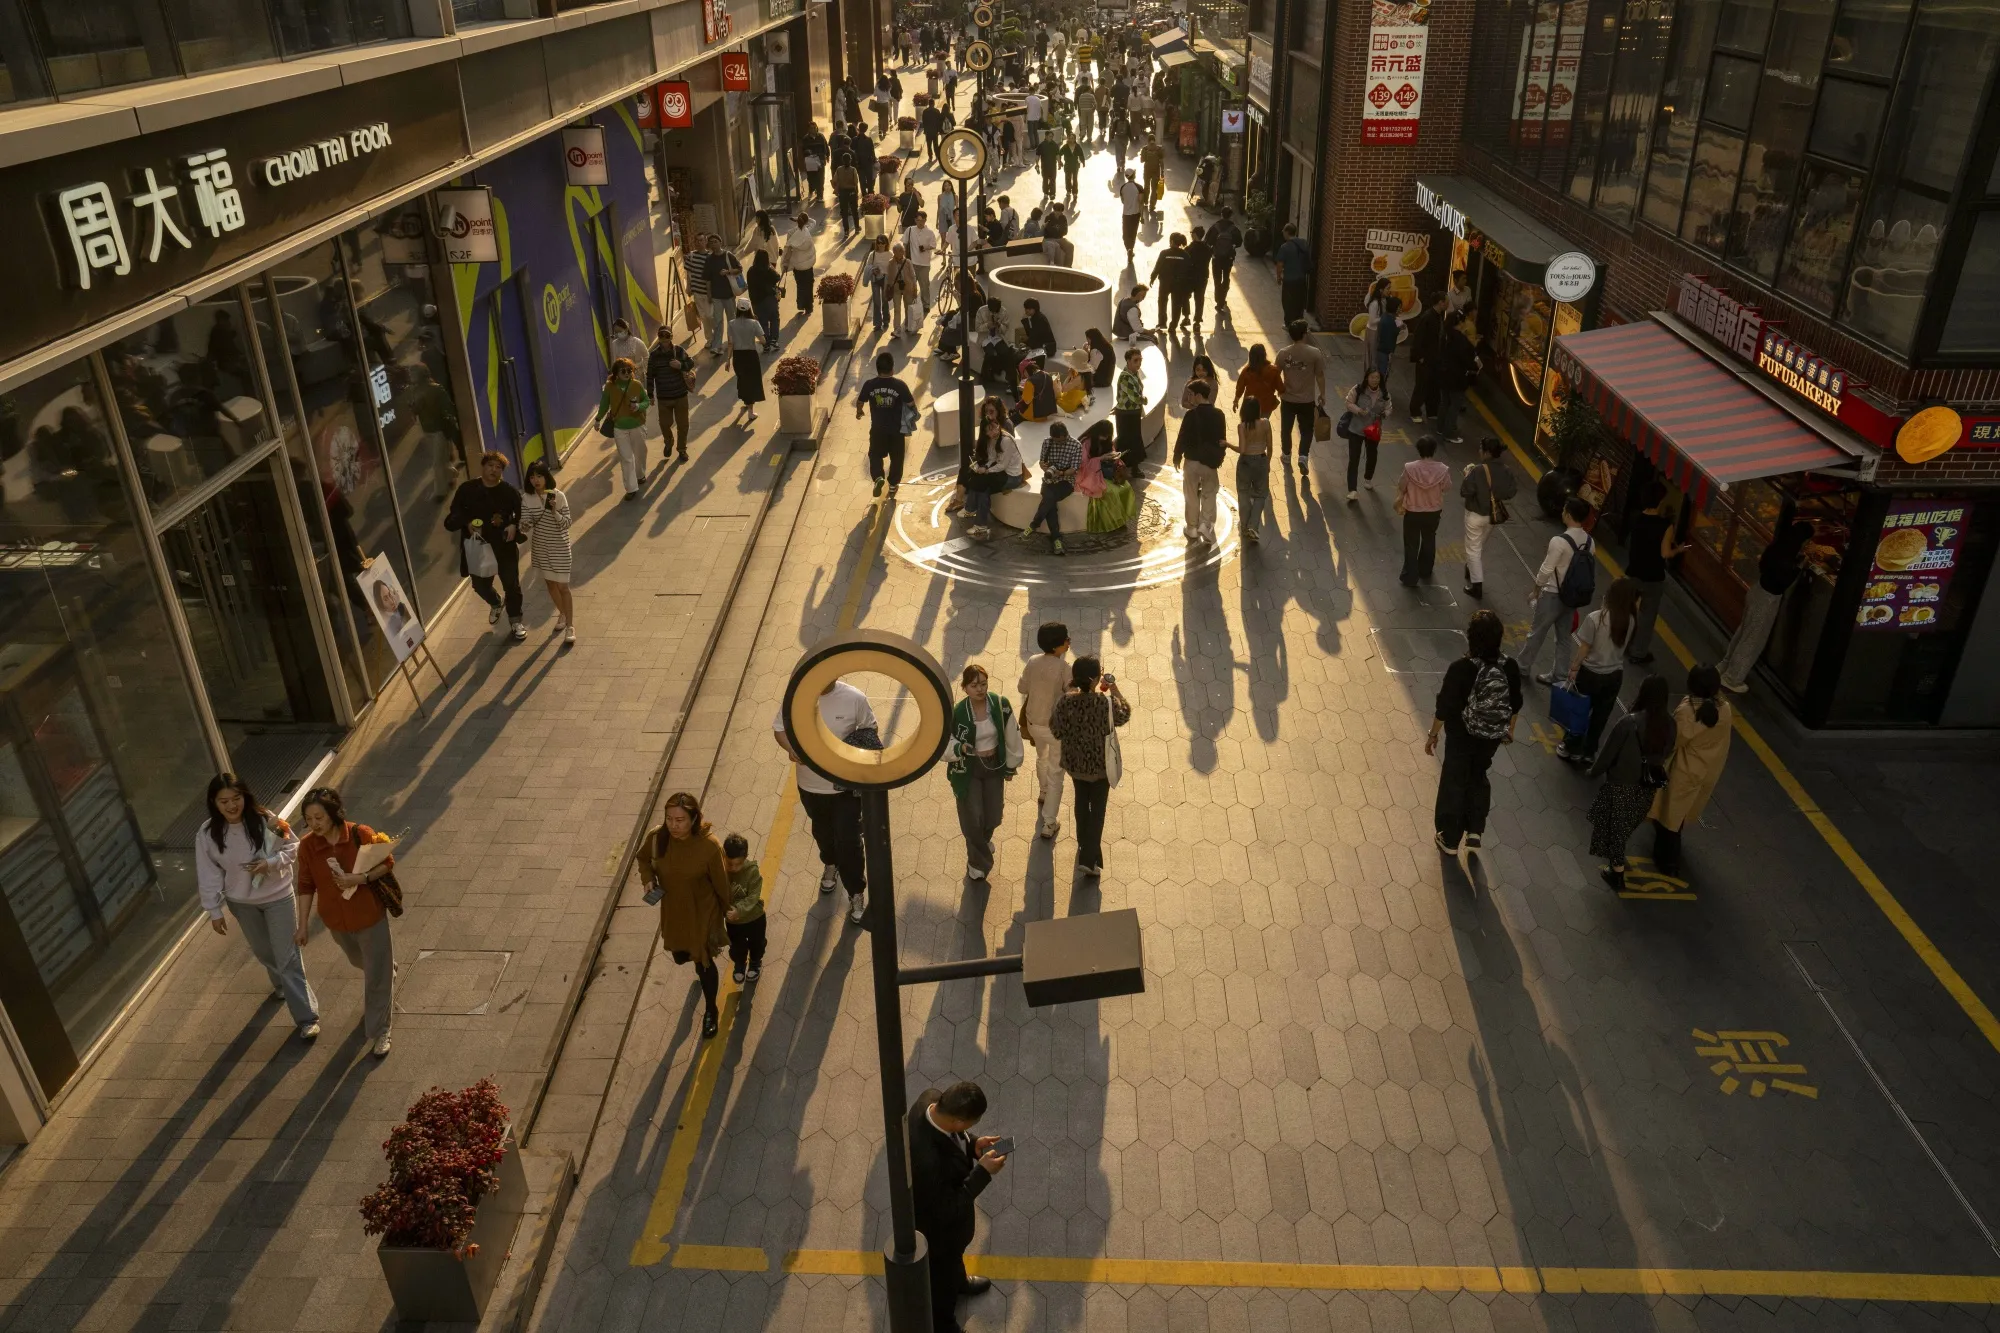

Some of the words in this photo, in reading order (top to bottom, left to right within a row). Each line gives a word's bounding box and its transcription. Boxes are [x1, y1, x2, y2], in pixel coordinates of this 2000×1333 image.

[734, 63, 747, 76] 24
[1371, 55, 1422, 72] 京元盛
[265, 146, 320, 187] CHOW
[318, 135, 349, 168] TAI
[350, 121, 393, 158] FOOK
[59, 147, 246, 290] 周大福
[1416, 181, 1435, 215] TOUS
[1440, 200, 1466, 240] JOURS
[470, 218, 492, 229] point
[1368, 230, 1429, 246] DURIAN
[460, 250, 472, 259] 2F
[1759, 352, 1842, 417] FUFUBAKERY
[1882, 508, 1965, 529] 福福必吃榜
